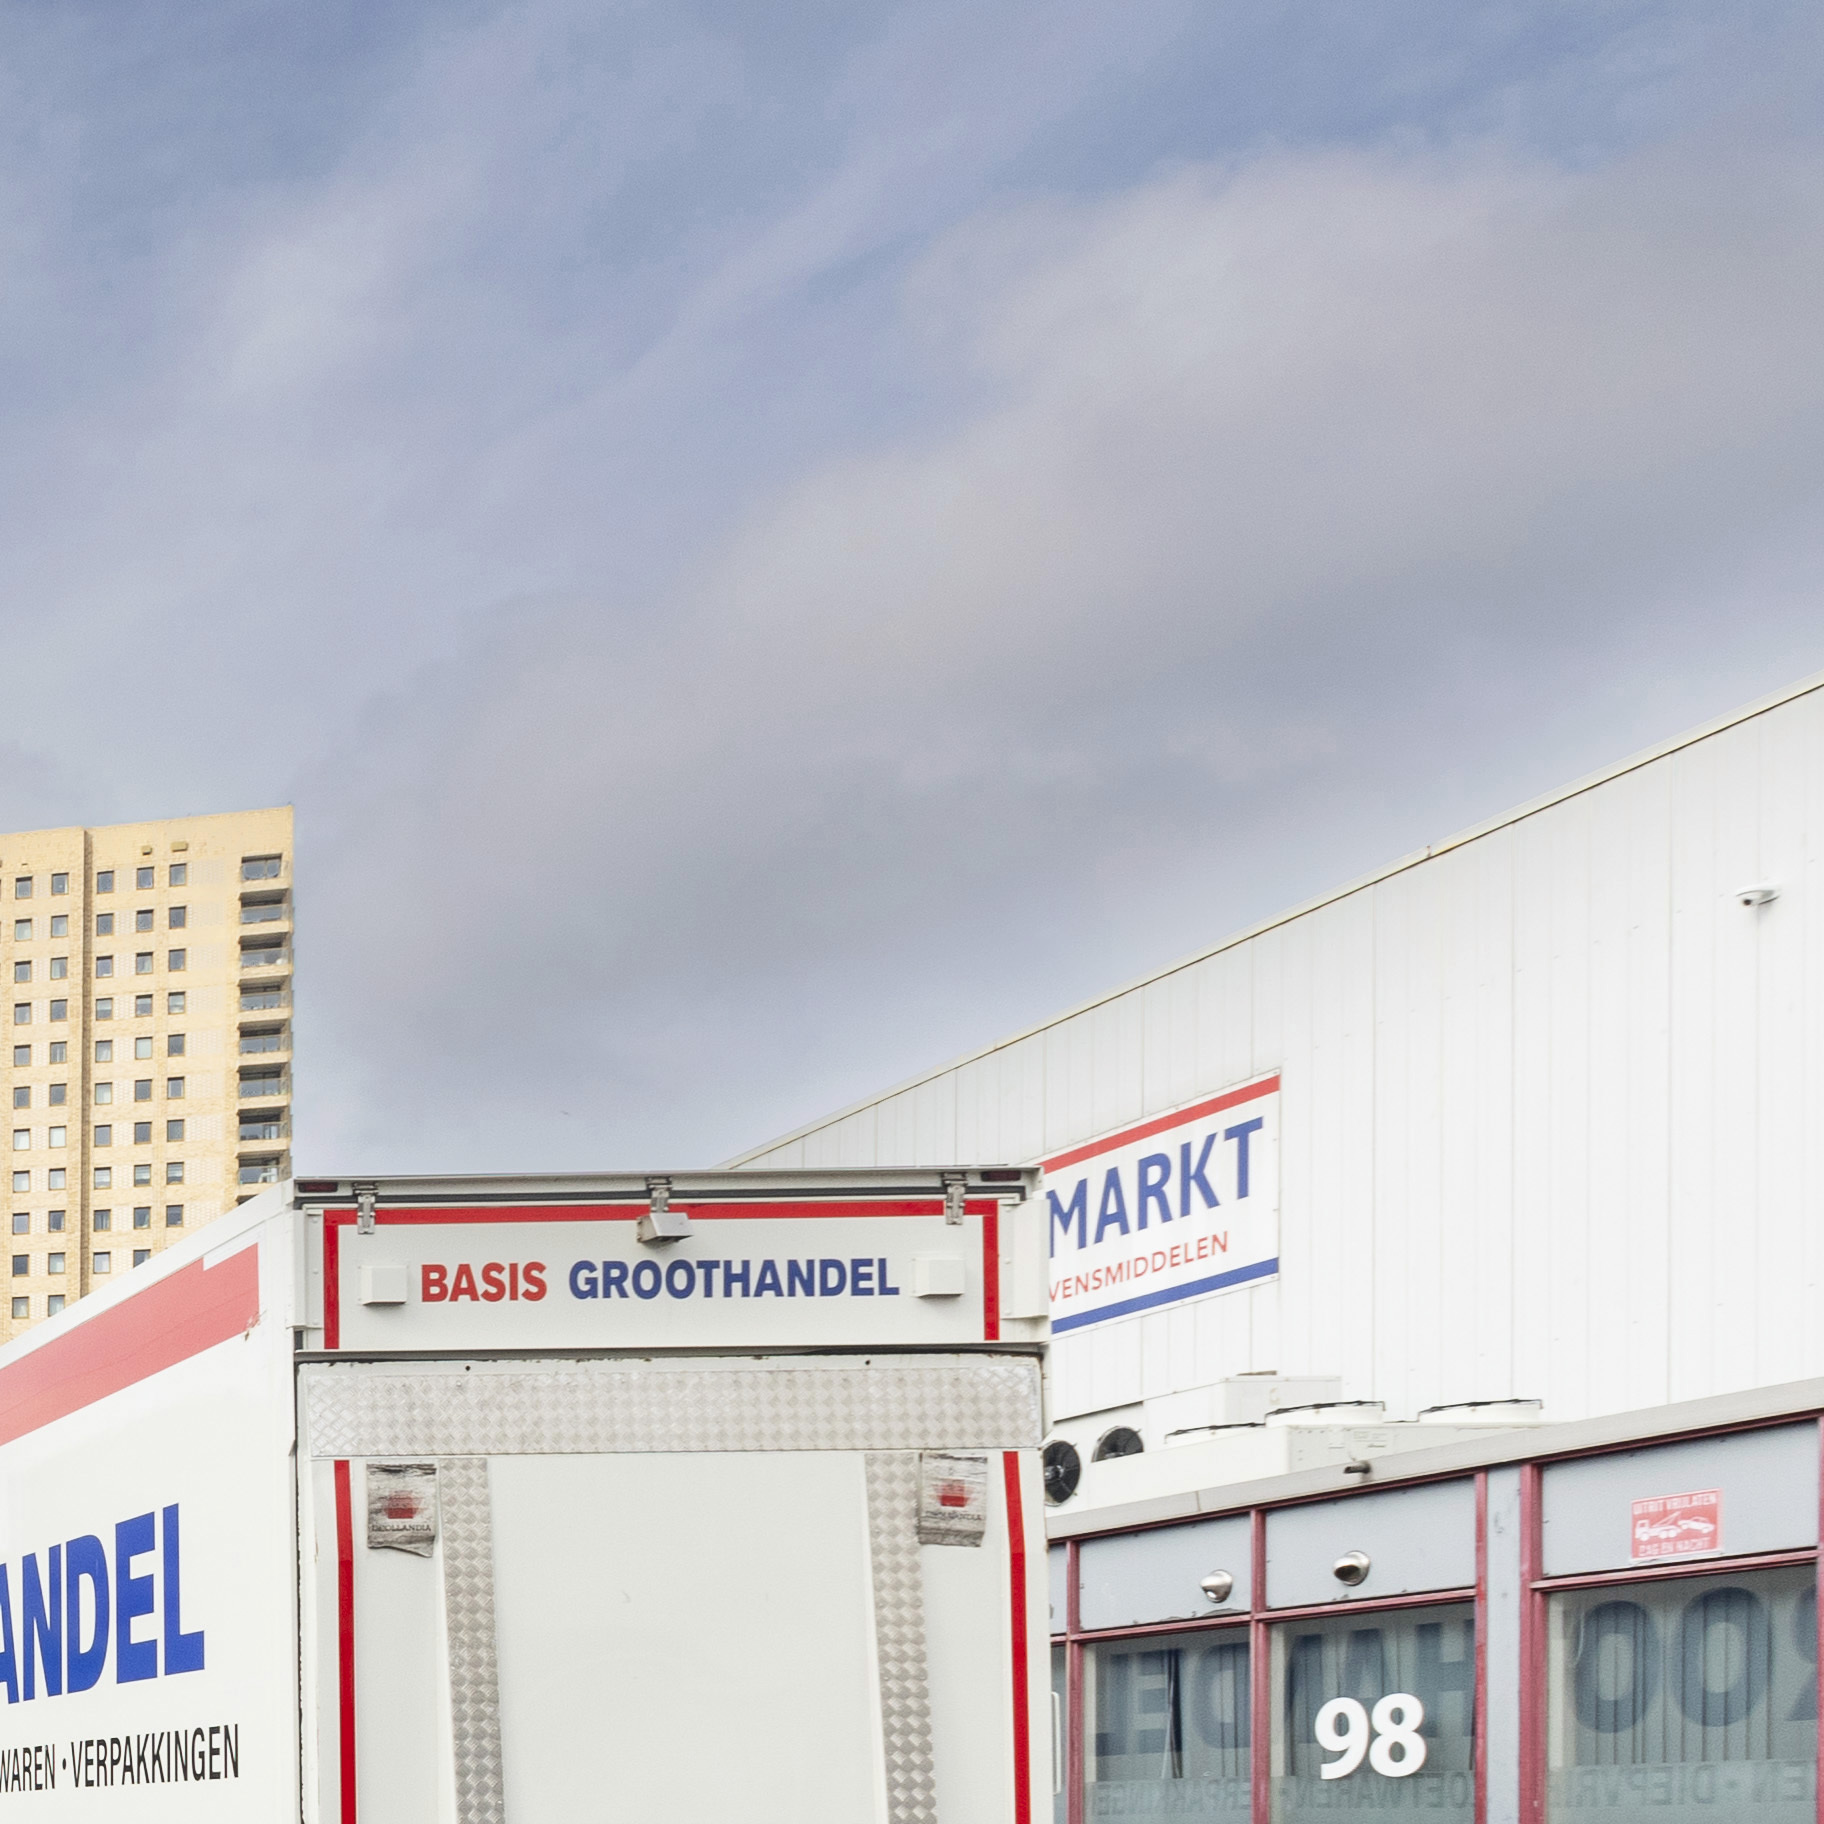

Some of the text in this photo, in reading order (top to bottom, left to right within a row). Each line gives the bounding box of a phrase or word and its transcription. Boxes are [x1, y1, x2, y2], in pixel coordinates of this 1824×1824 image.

[1046, 1116, 1263, 1259] MARKT
[421, 1257, 900, 1303] BASIS GROOTHANDEL
[71, 1723, 240, 1788] VERPAKKINGEN
[1314, 1692, 1427, 1780] 98
